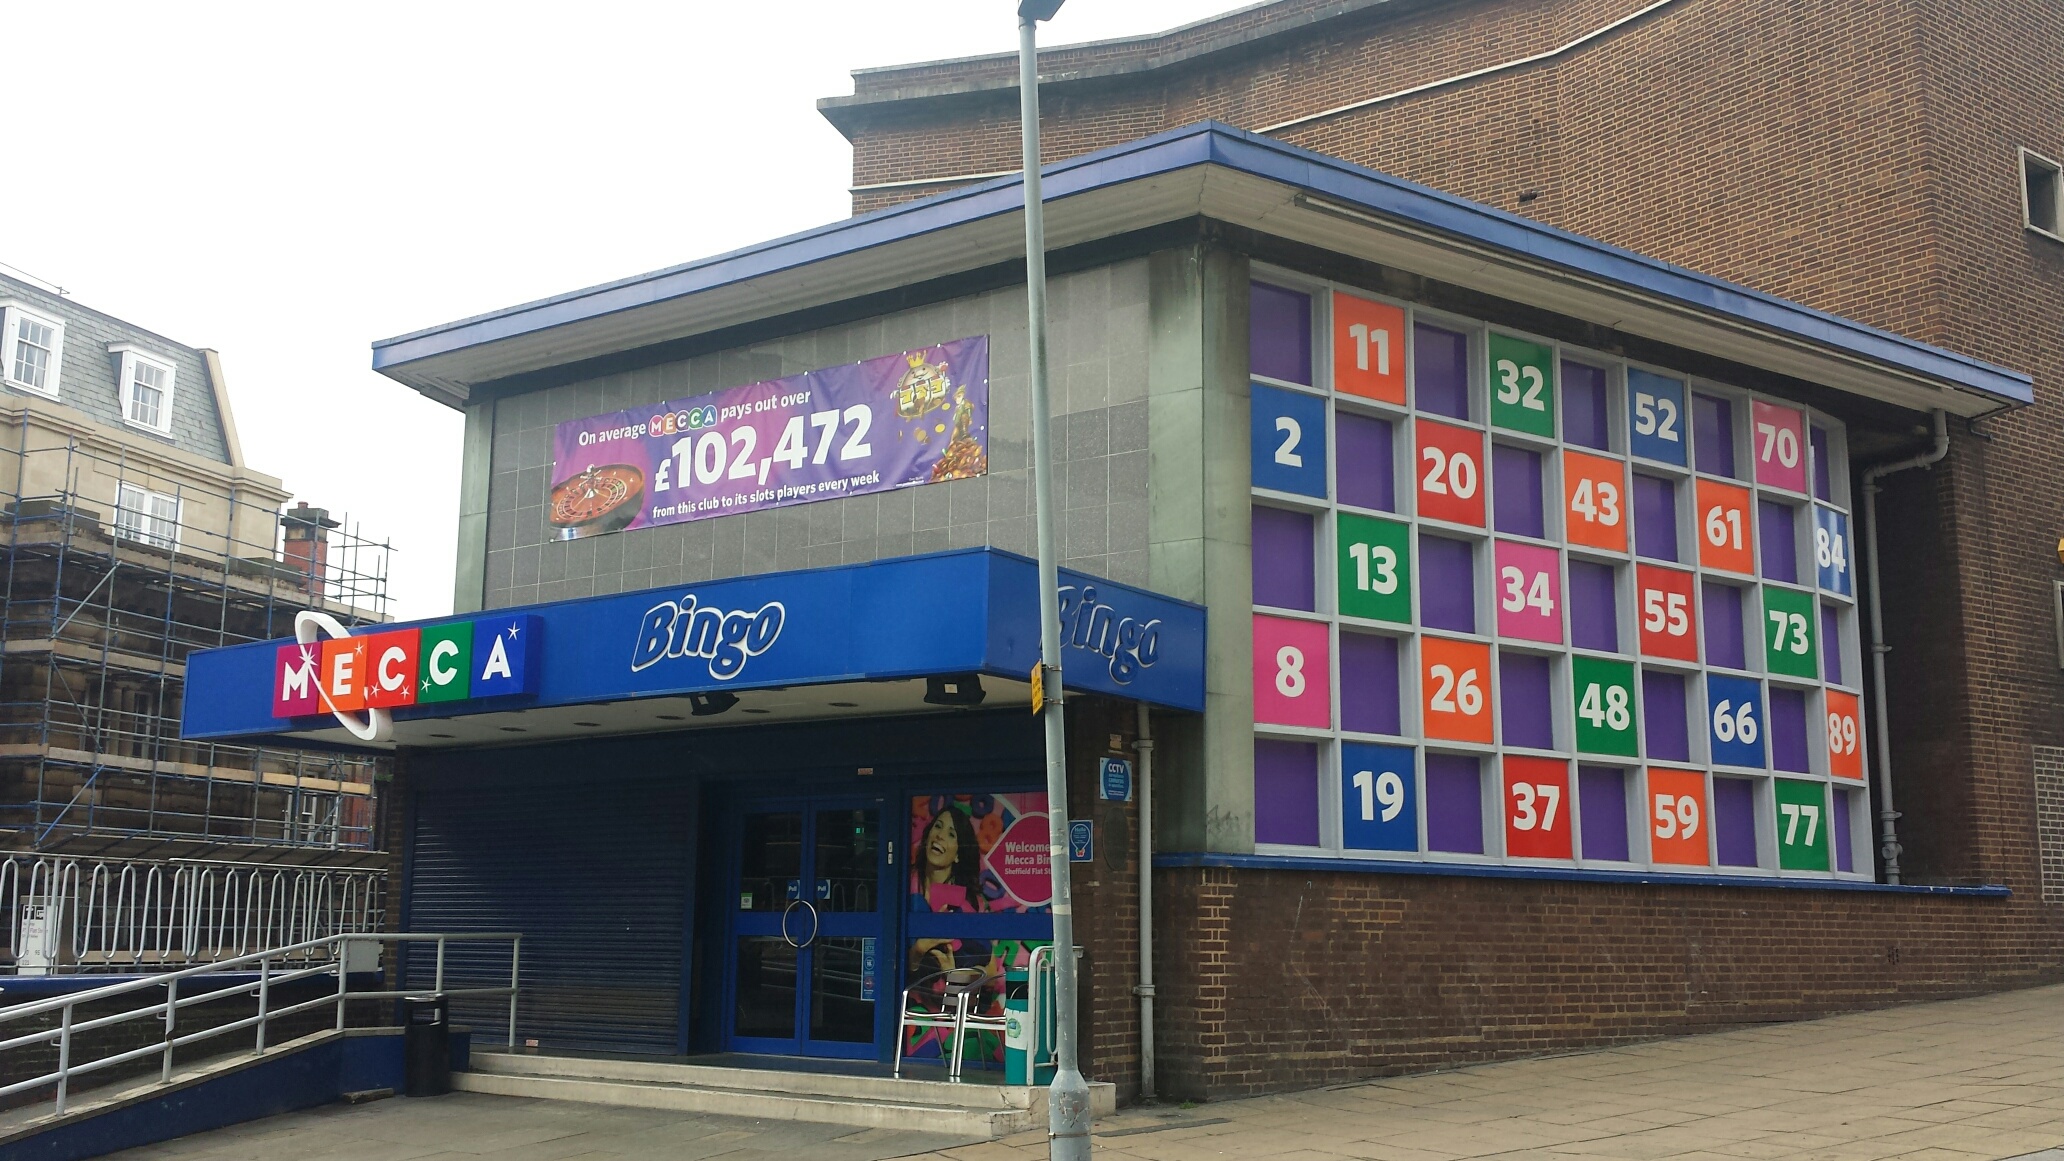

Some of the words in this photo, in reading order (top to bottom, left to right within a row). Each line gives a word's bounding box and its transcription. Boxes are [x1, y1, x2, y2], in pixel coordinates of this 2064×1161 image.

[1349, 323, 1389, 376] 11
[1497, 359, 1545, 411] 32
[579, 431, 596, 446] On
[598, 422, 646, 443] average
[650, 407, 716, 434] MECCA
[720, 404, 751, 422] pays
[755, 395, 777, 413] out
[781, 391, 811, 408] over
[1634, 392, 1679, 442] 52
[654, 403, 873, 492] £102,472
[1275, 416, 1302, 468] 2
[1757, 422, 1799, 469] 70
[652, 505, 675, 518] from
[677, 500, 696, 514] this
[698, 496, 719, 512] club
[721, 496, 733, 507] to
[735, 492, 747, 505] its
[749, 488, 775, 503] slots
[777, 482, 816, 501] players
[818, 476, 848, 493] every
[851, 470, 880, 487] week
[1422, 446, 1477, 499] 20
[1572, 478, 1620, 526] 43
[1706, 506, 1743, 550] 61
[1816, 527, 1846, 573] 84
[1349, 542, 1398, 595] 13
[1502, 566, 1554, 617] 34
[1644, 588, 1689, 636] 55
[1769, 609, 1809, 655] 73
[631, 594, 785, 681] Bingo
[281, 634, 513, 702] MECCA
[1275, 645, 1305, 697] 8
[1430, 664, 1483, 716] 26
[1578, 683, 1630, 731] 48
[1713, 699, 1758, 744] 66
[1828, 712, 1856, 756] 89
[1108, 763, 1124, 774] CCTV
[1352, 770, 1404, 822] 19
[1512, 782, 1560, 831] 37
[1655, 794, 1699, 840] 59
[1005, 841, 1051, 853] Welcome
[1780, 803, 1819, 847] 77
[1004, 867, 1031, 875] Sheffield
[1005, 854, 1035, 865] Mecca
